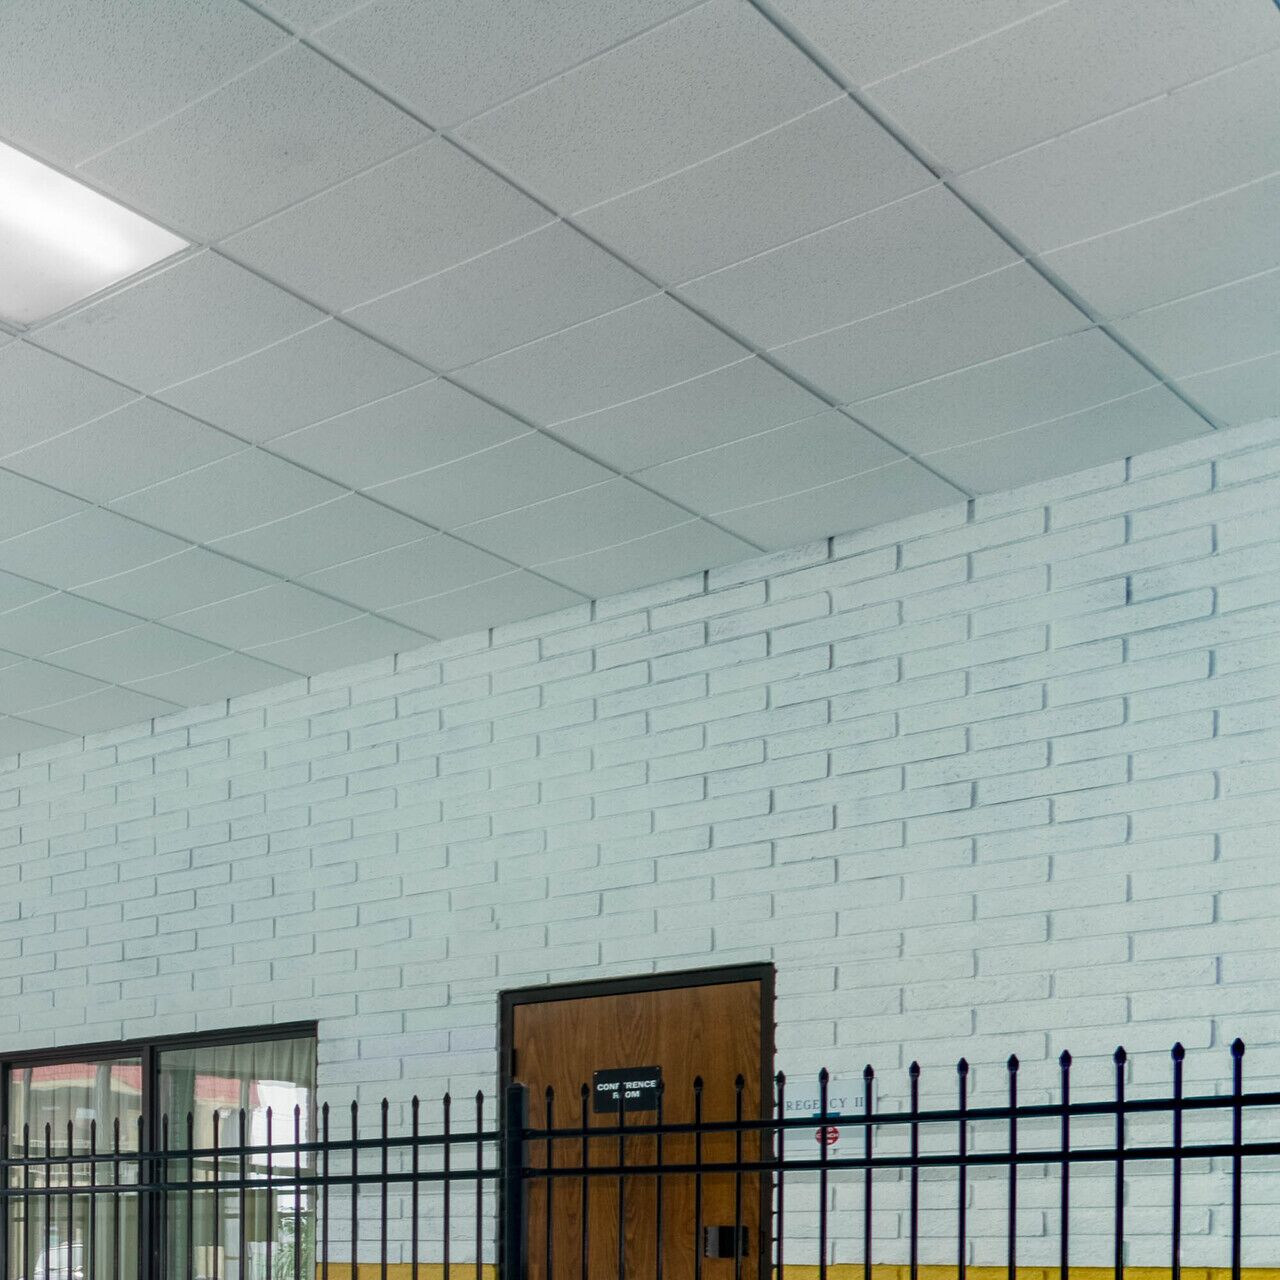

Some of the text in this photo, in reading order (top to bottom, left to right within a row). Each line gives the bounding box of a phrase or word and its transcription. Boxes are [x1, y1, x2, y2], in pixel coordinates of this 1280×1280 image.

[597, 1080, 656, 1091] CONFRENCE
[612, 1091, 640, 1099] ROM
[786, 1098, 847, 1111] REGECY
